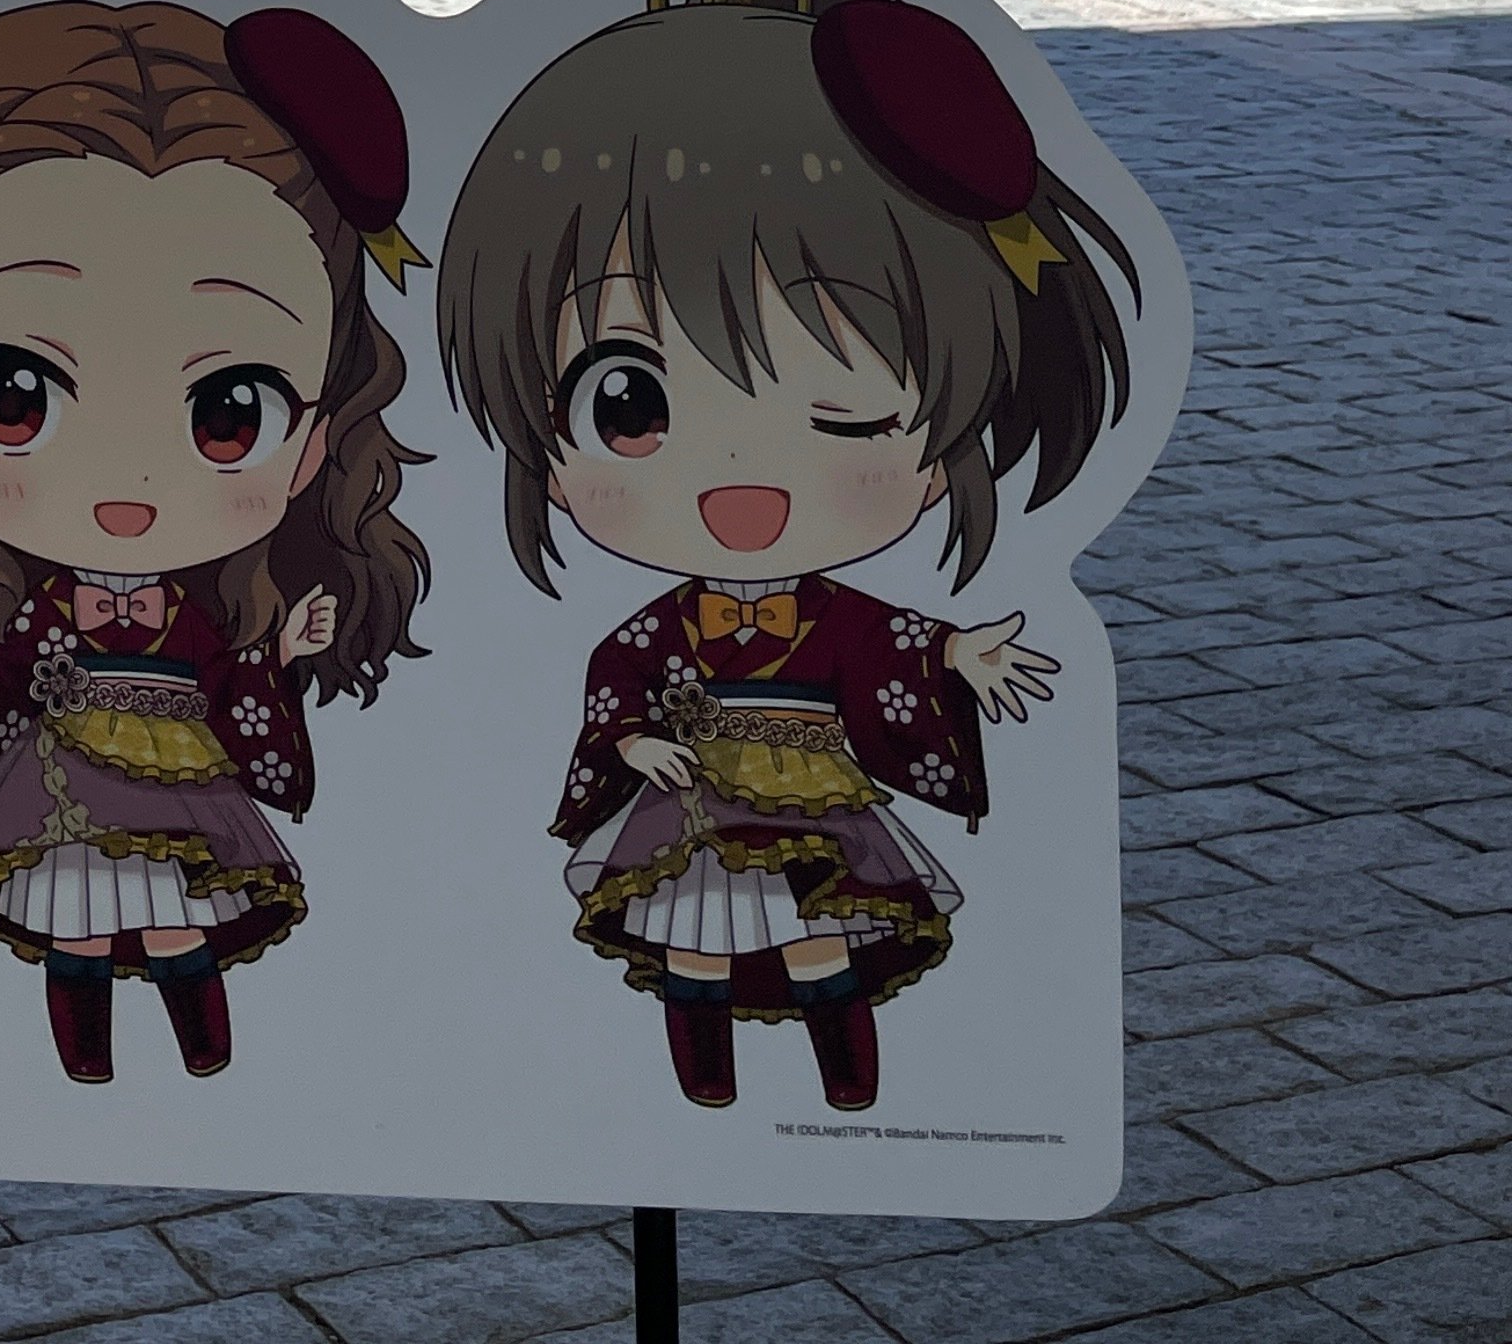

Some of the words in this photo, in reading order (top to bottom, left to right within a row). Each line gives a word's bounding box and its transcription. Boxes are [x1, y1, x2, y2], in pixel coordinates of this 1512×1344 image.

[775, 1123, 795, 1136] THE
[931, 1128, 968, 1141] Namco
[971, 1130, 1045, 1142] Entertainment
[1048, 1133, 1066, 1144] Inc.
